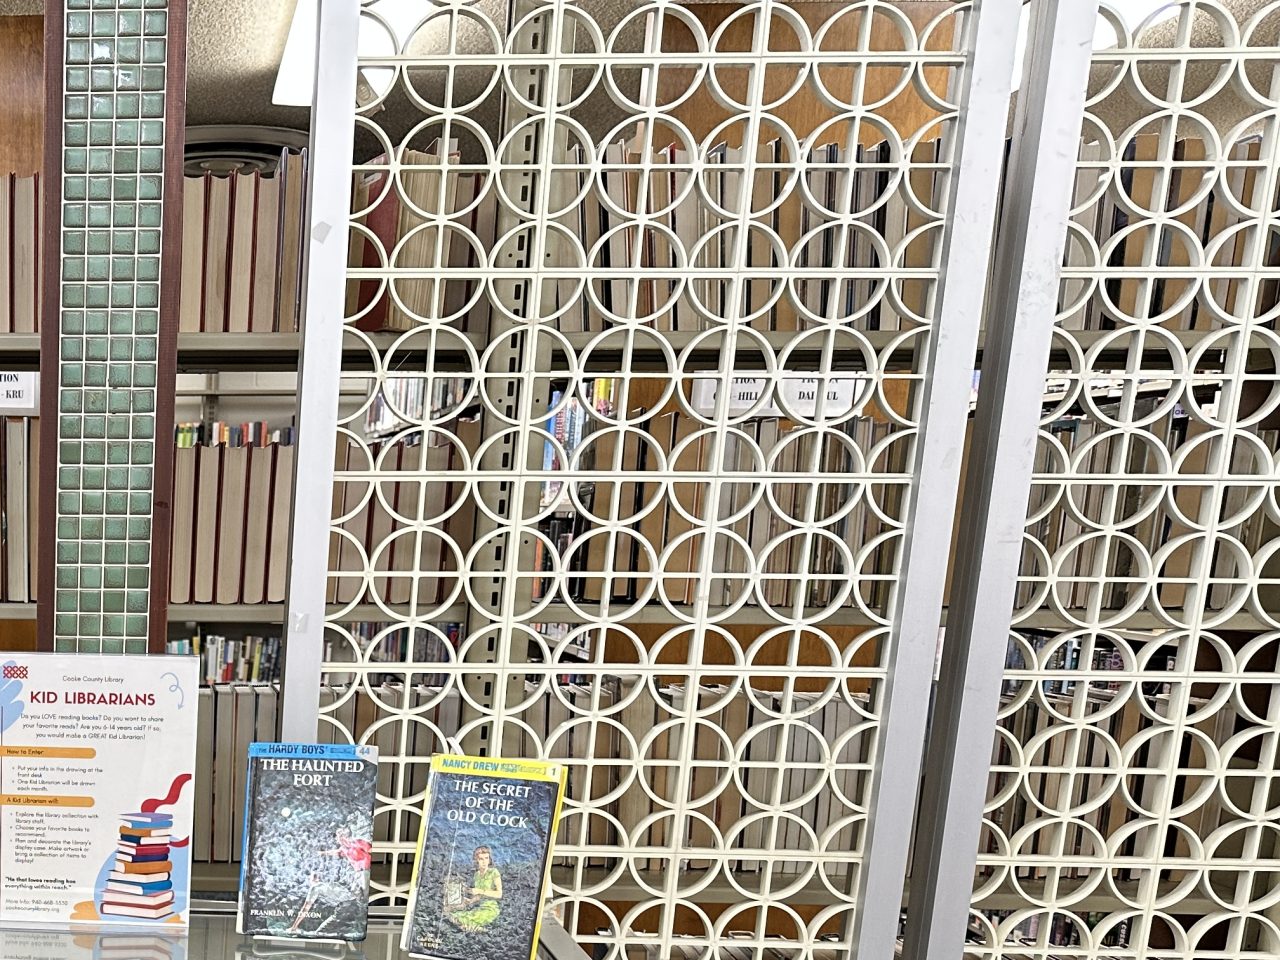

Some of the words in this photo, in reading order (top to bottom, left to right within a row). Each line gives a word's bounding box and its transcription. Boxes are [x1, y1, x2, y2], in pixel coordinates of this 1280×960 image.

[6, 390, 24, 399] KRU
[737, 391, 759, 401] HILL
[83, 676, 103, 684] County
[105, 676, 124, 684] Library
[30, 691, 58, 704] KID
[65, 692, 156, 706] LIBRARIANS
[268, 745, 299, 754] HARDY
[359, 747, 370, 755] 44
[260, 759, 289, 771] THE
[291, 759, 365, 773] HAUNTED
[442, 758, 472, 769] NANCY
[473, 761, 499, 771] DREW
[551, 767, 557, 776] 1
[293, 774, 333, 787] FORT
[454, 780, 479, 793] THE
[482, 782, 532, 798] SECRET
[465, 796, 484, 809] OF
[488, 798, 514, 811] THE
[447, 809, 476, 823] OLD
[480, 813, 529, 829] CLOCK
